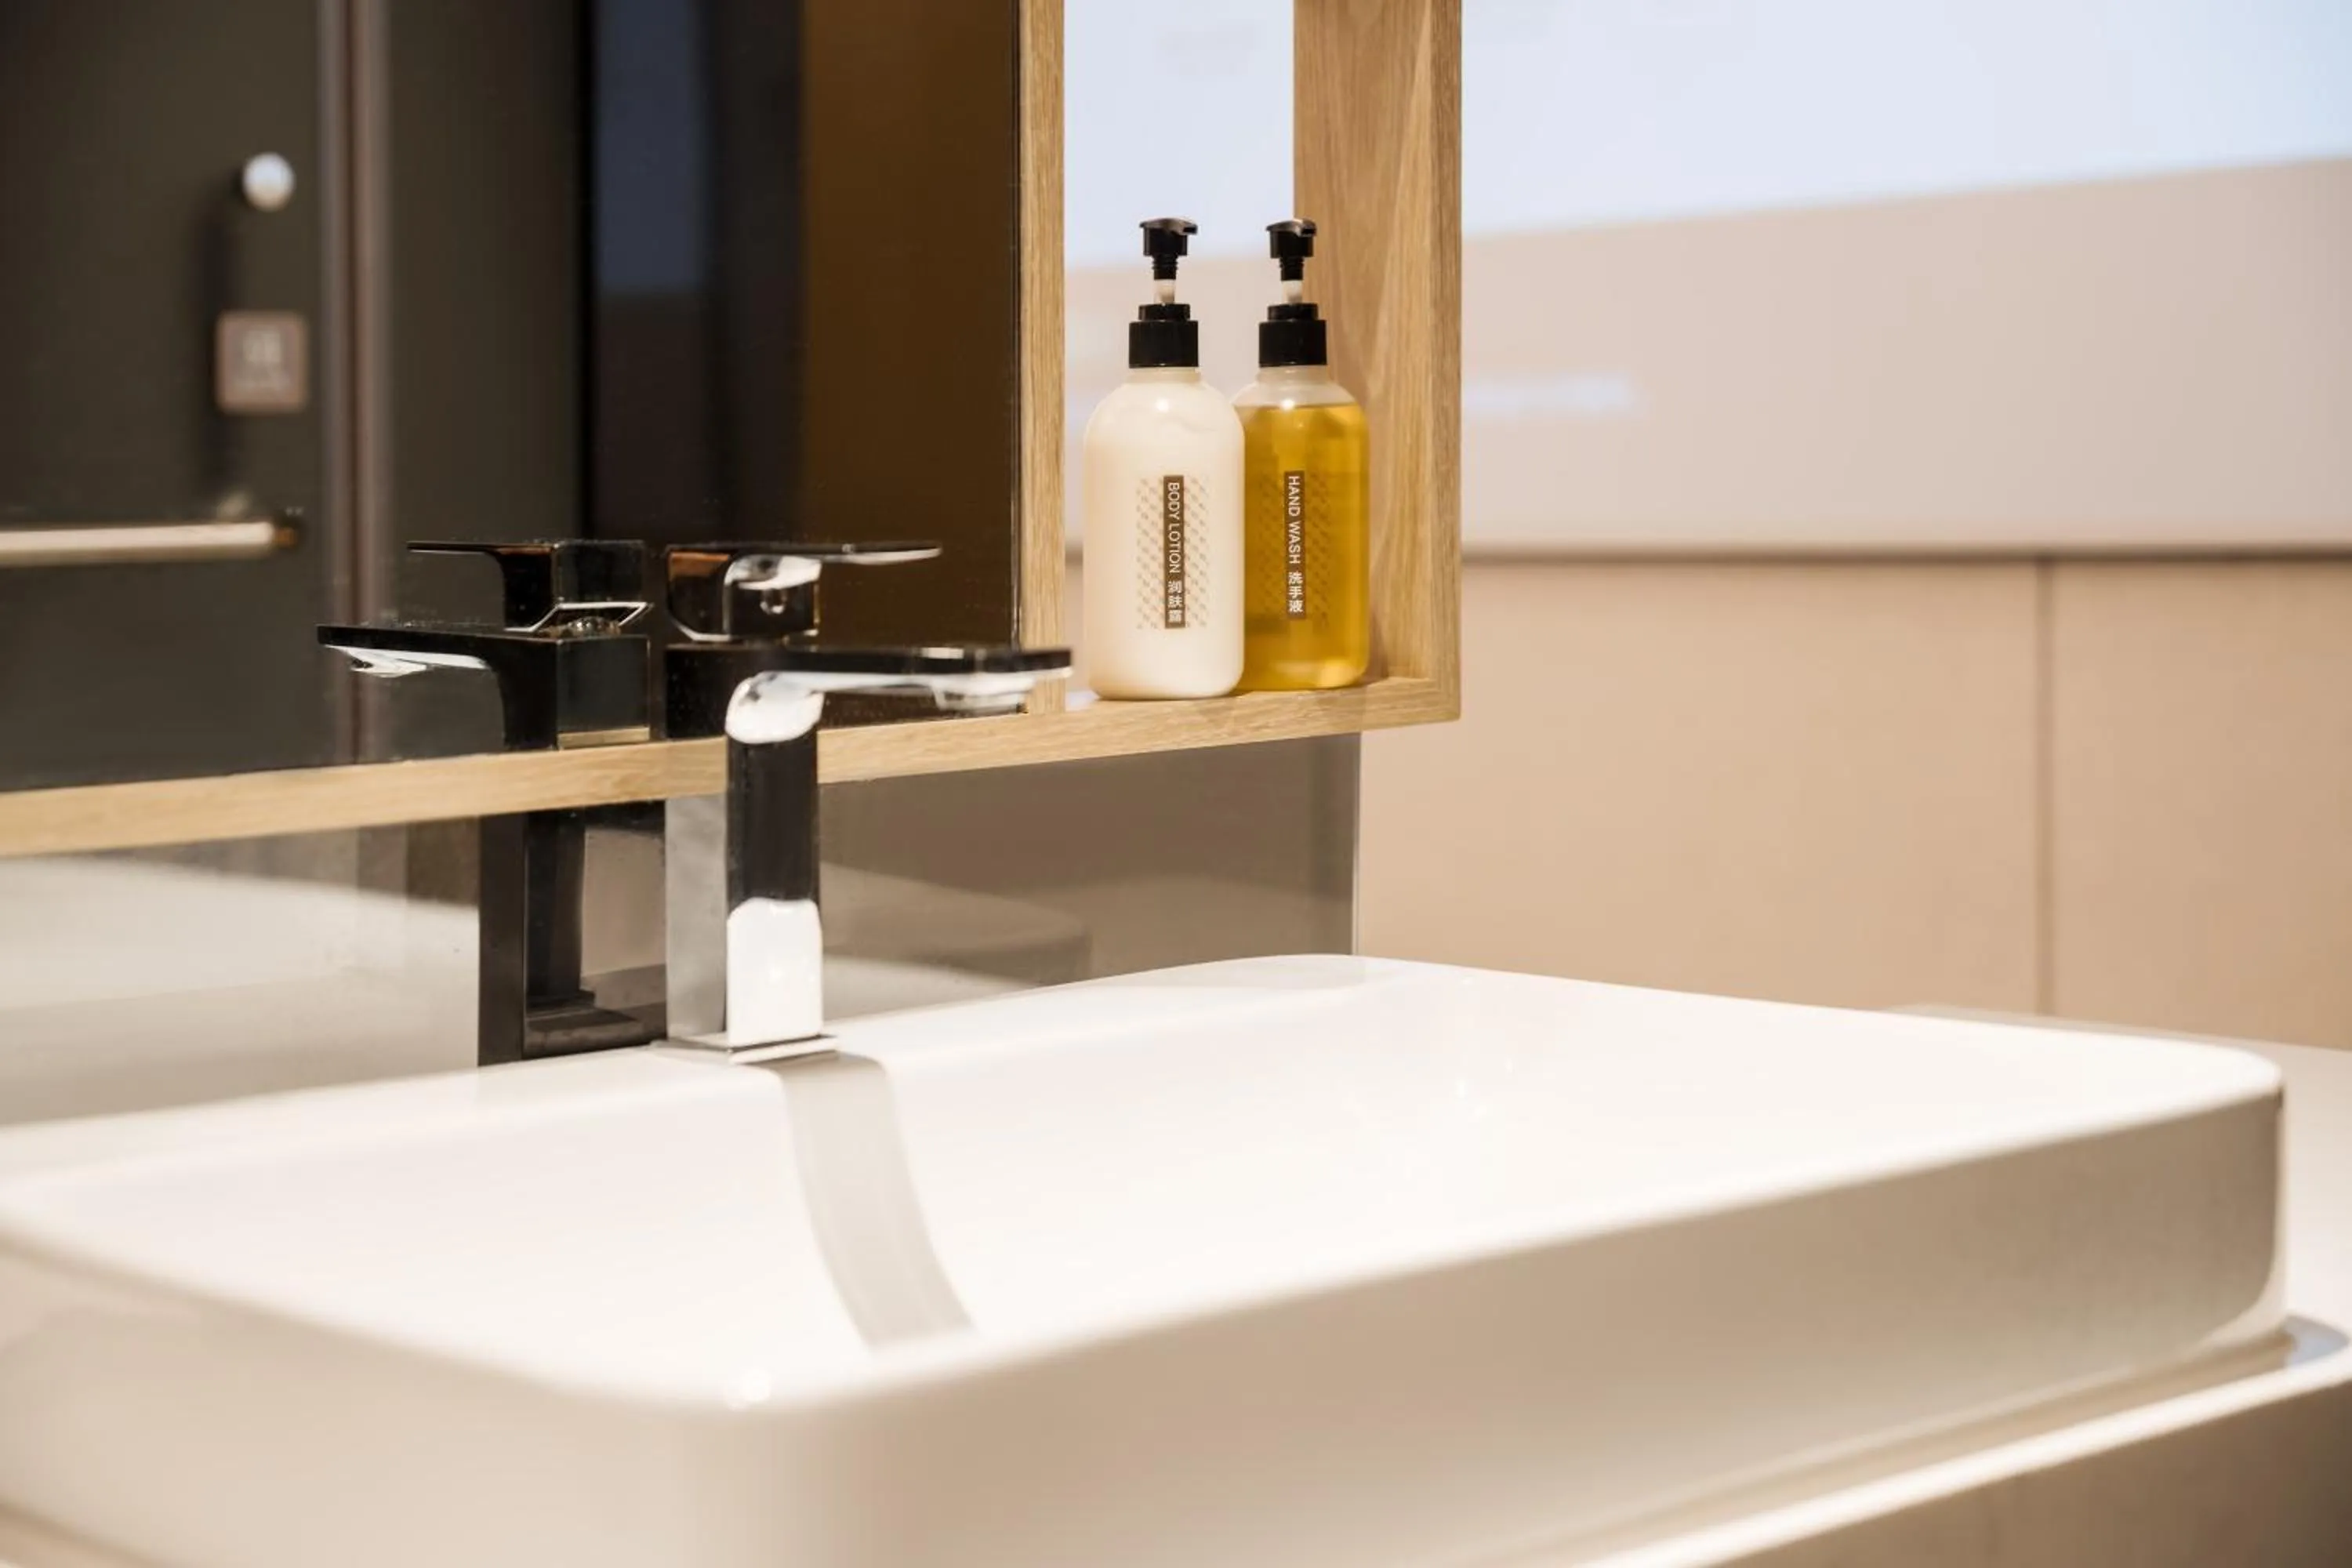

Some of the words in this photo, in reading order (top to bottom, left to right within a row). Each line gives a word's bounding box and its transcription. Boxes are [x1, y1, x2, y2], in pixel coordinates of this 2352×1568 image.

[1167, 482, 1180, 520] BODY
[1288, 476, 1301, 517] HAND
[1168, 523, 1181, 573] LOTION
[1288, 521, 1301, 564] WASH
[1288, 571, 1303, 612] 洗手液
